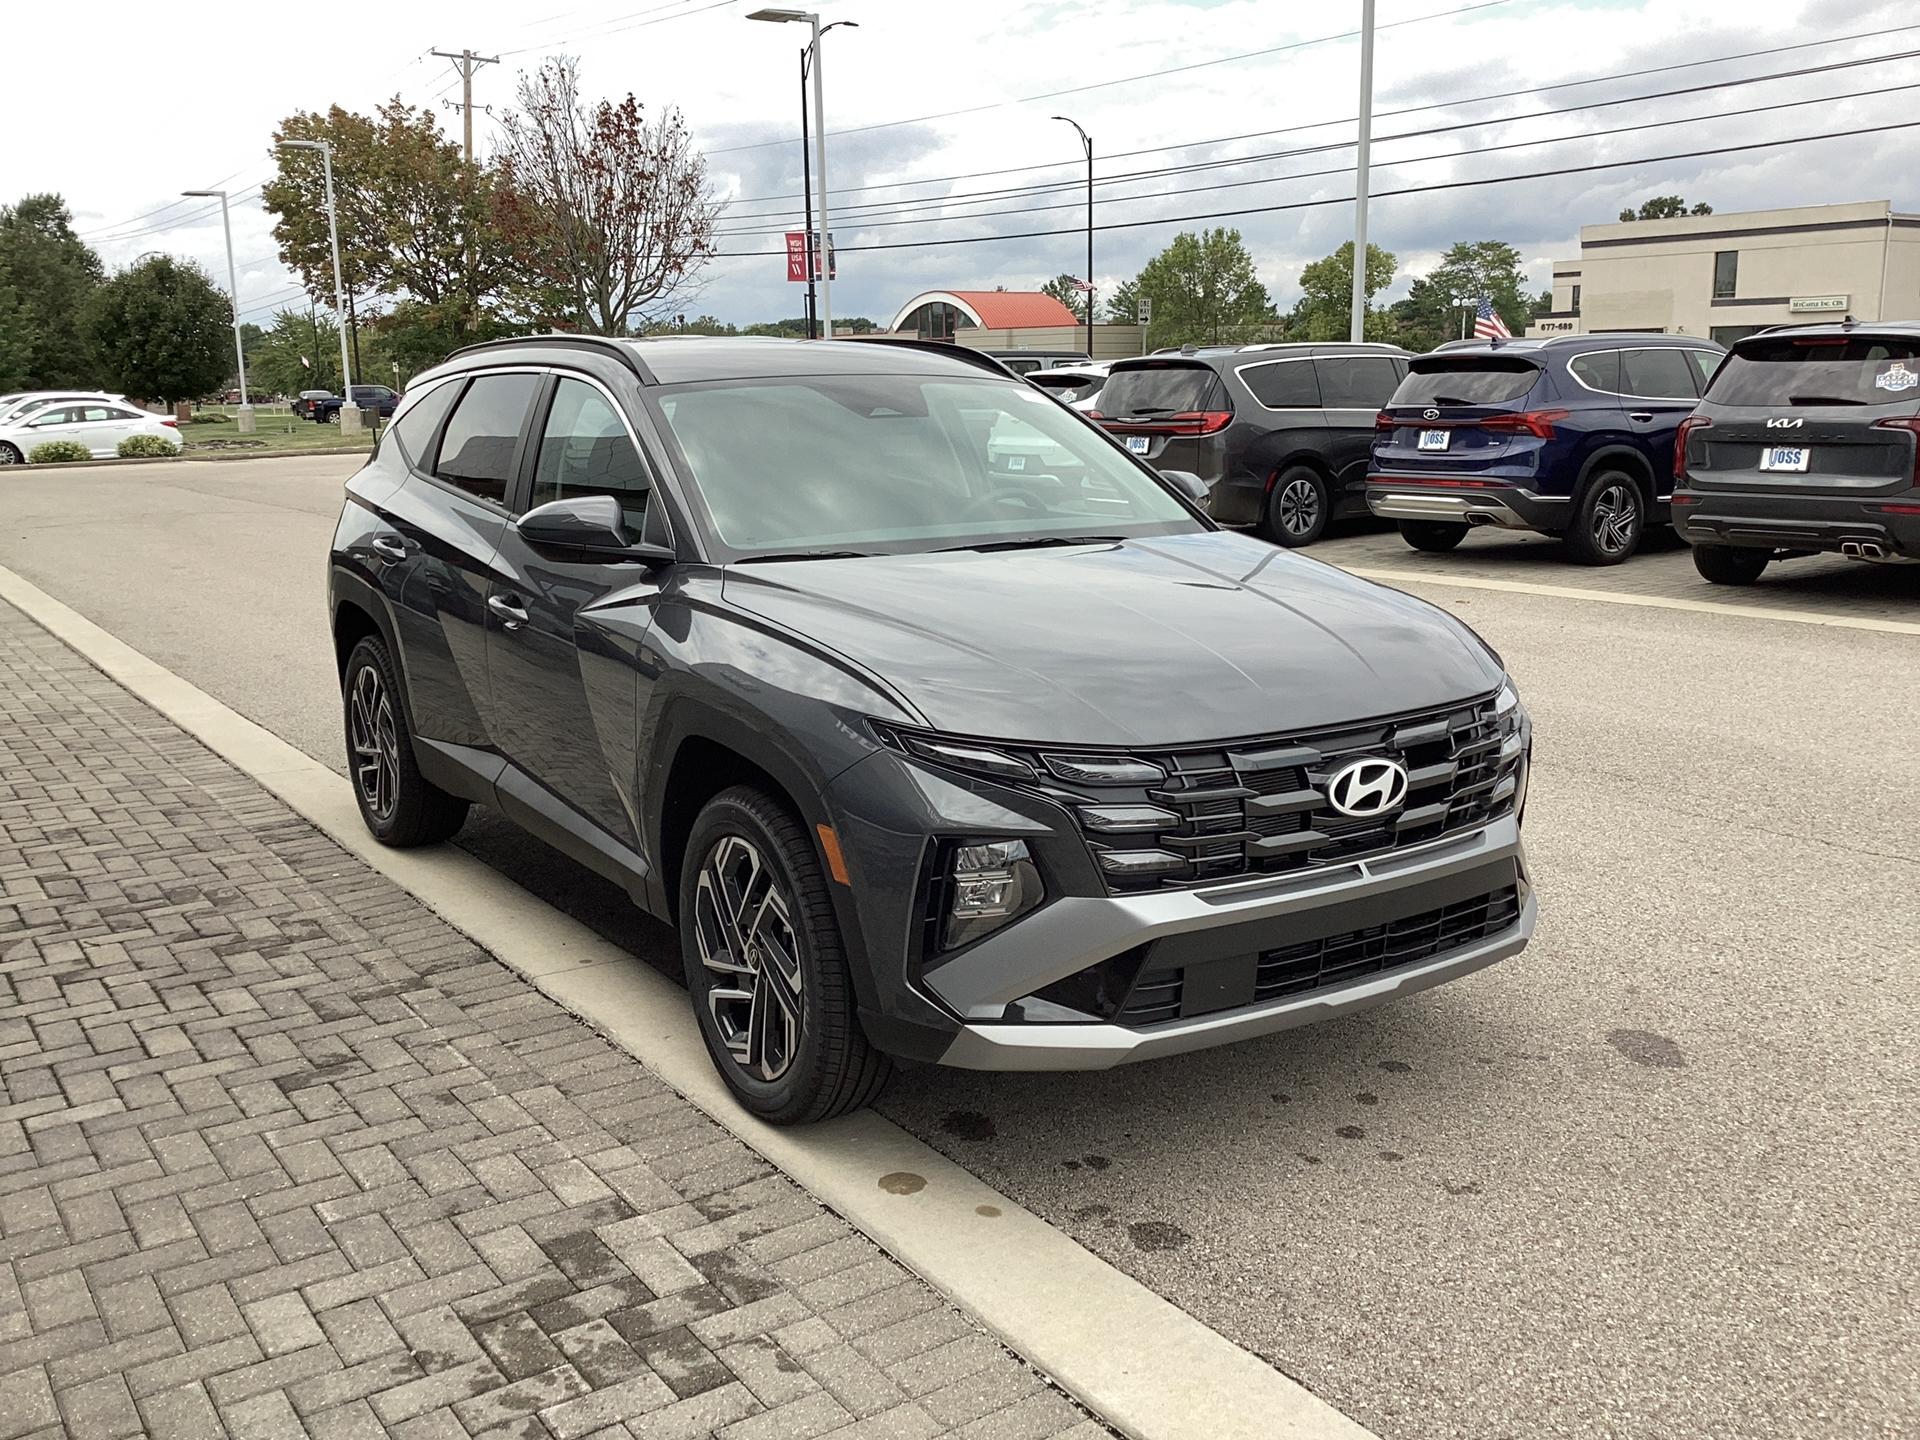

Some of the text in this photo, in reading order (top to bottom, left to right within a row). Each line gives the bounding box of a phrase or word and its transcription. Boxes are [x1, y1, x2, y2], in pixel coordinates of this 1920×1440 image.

[791, 254, 803, 262] USA
[1541, 322, 1573, 331] 677-689
[1766, 418, 1804, 428] KIA
